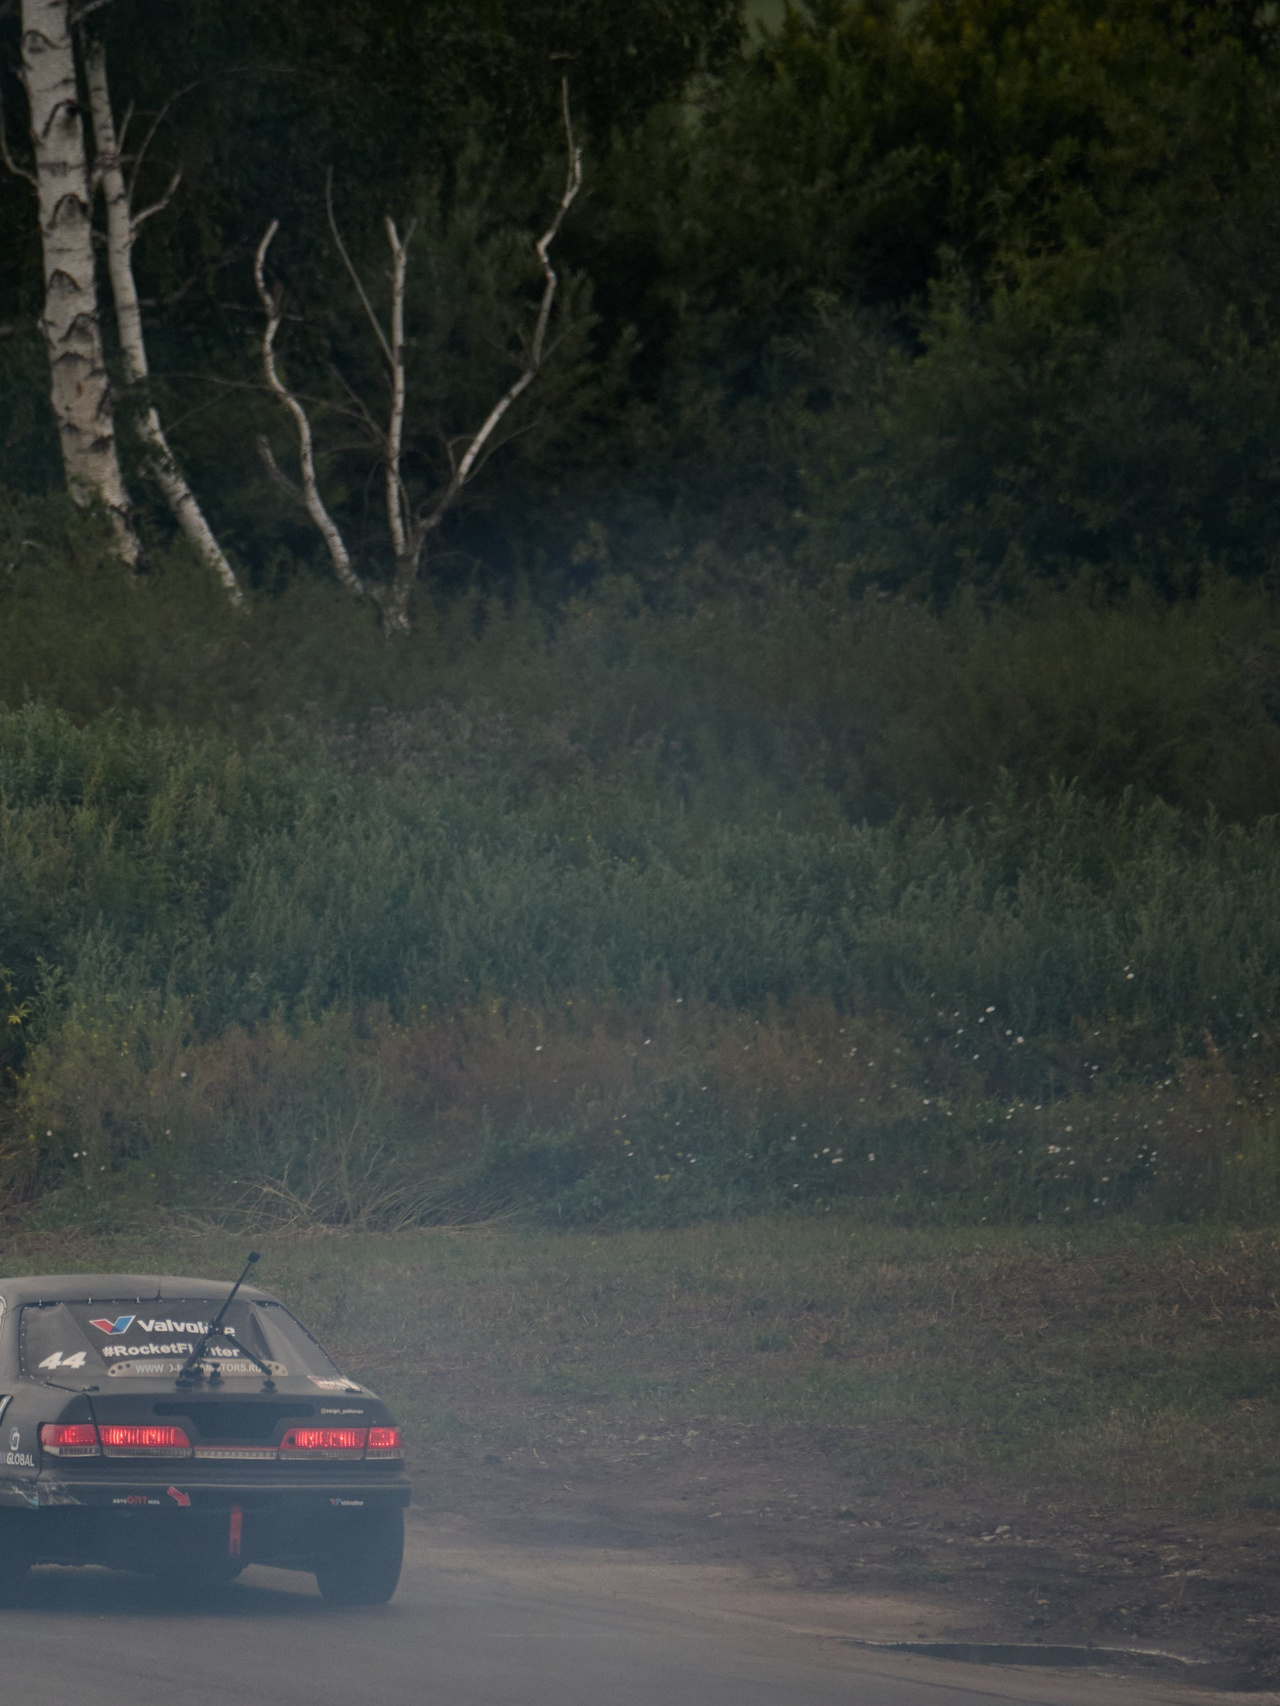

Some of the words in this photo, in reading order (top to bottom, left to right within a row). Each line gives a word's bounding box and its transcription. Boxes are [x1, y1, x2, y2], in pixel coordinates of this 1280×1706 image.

[136, 1319, 236, 1337] Valvolie
[102, 1342, 240, 1358] #RocketFiter
[38, 1351, 87, 1370] 44
